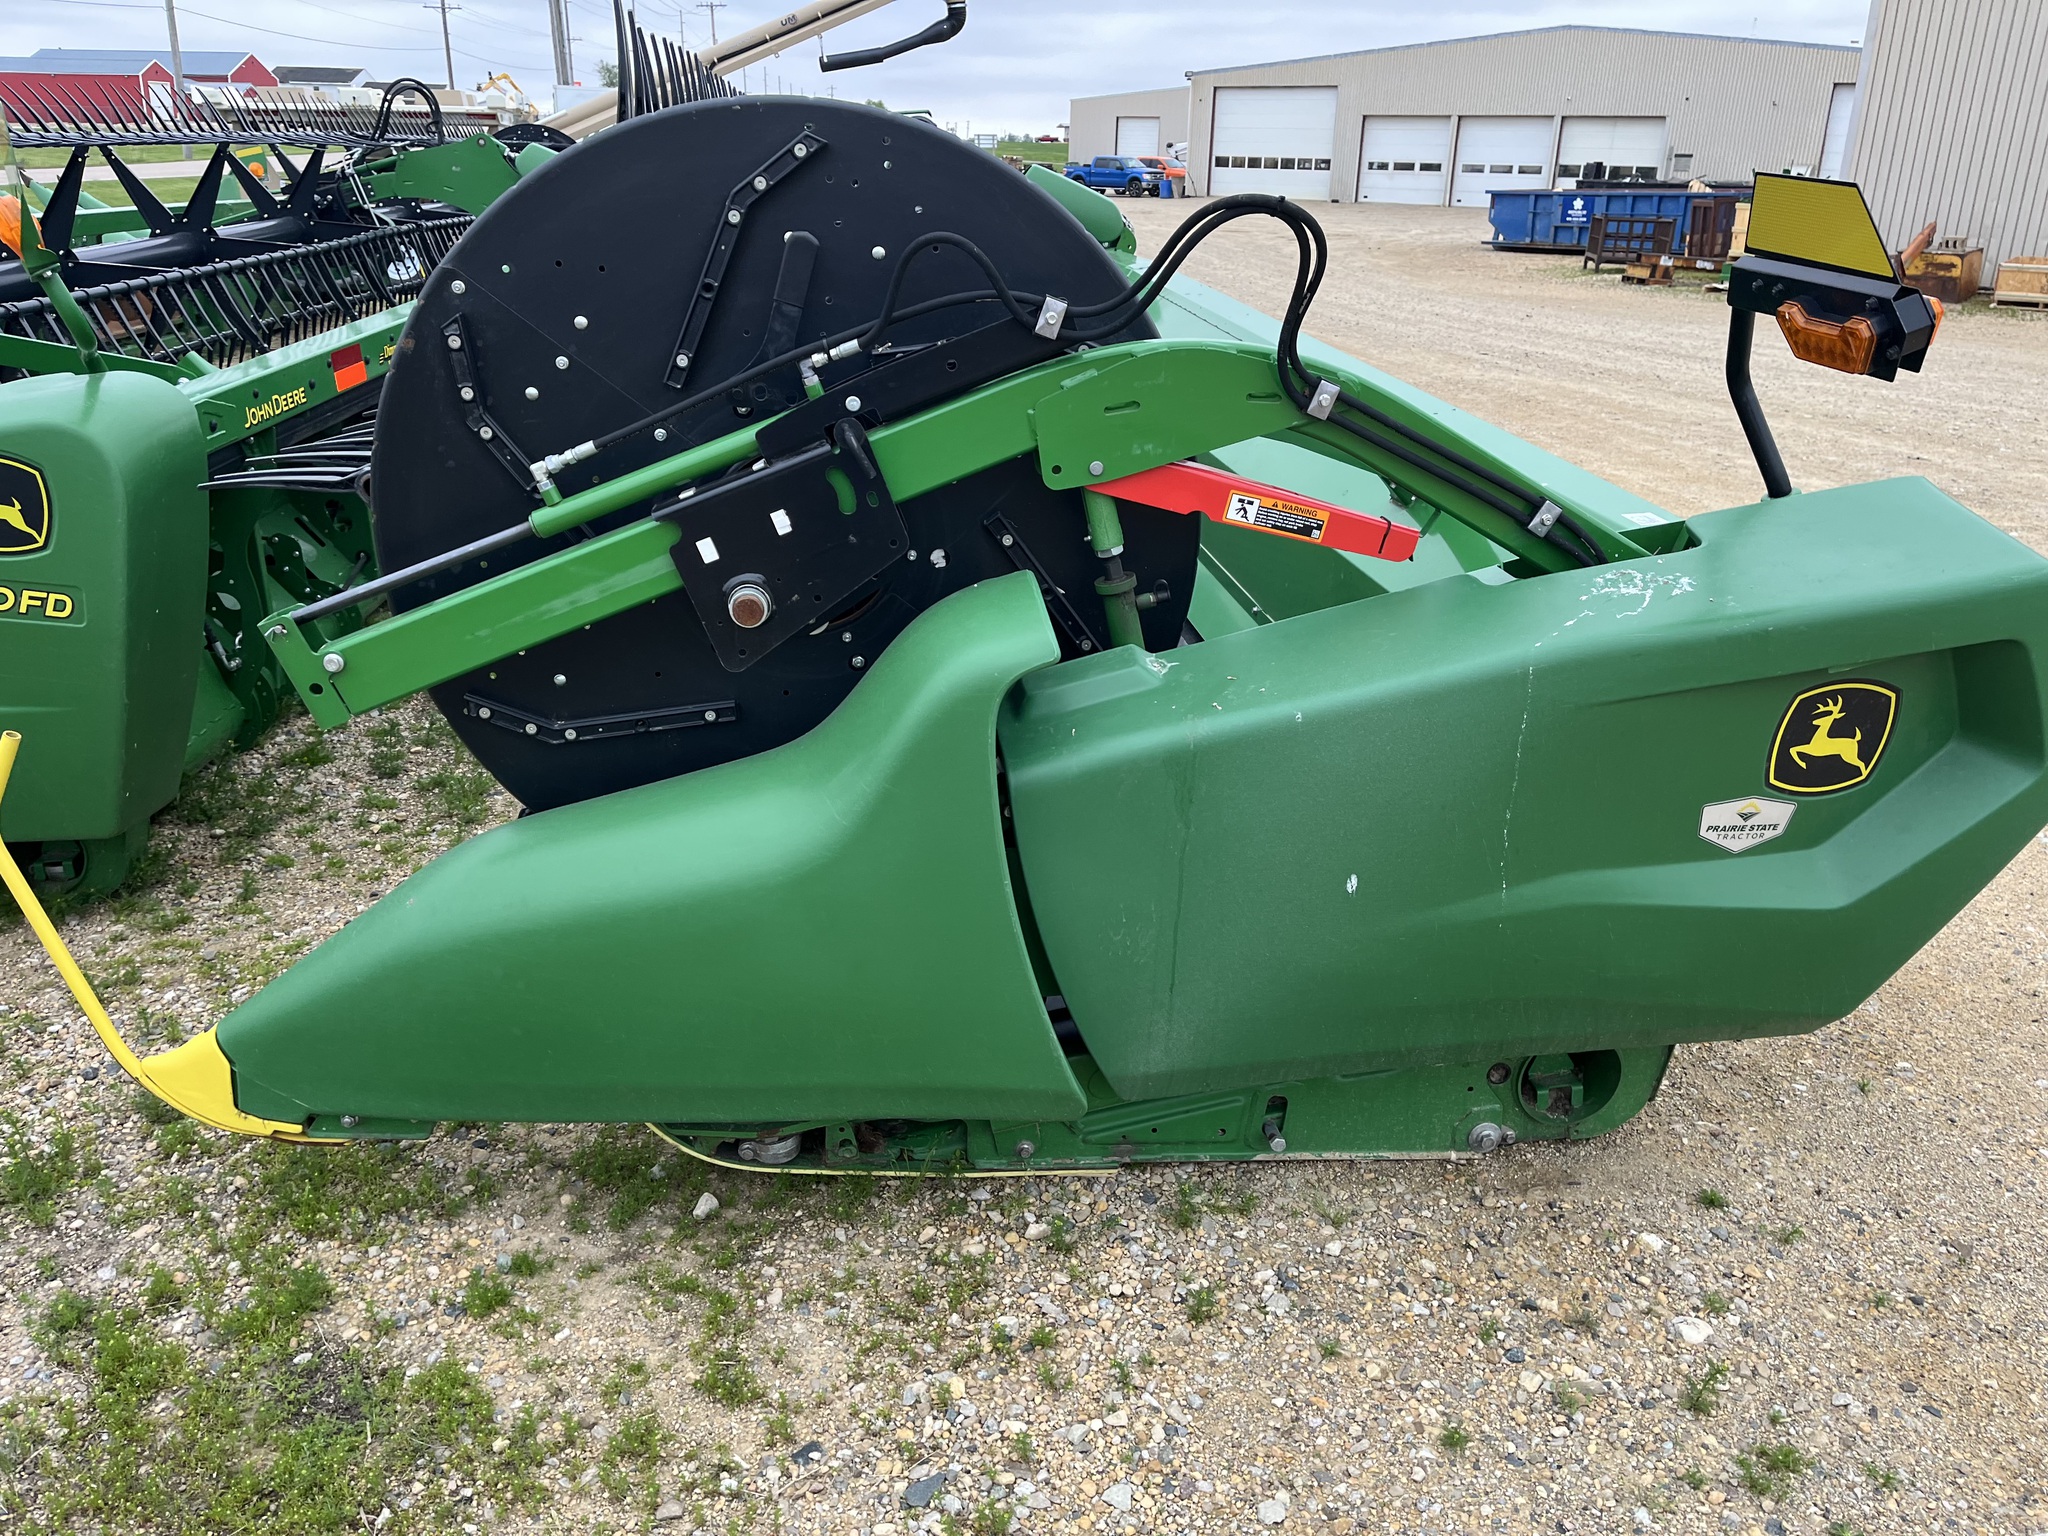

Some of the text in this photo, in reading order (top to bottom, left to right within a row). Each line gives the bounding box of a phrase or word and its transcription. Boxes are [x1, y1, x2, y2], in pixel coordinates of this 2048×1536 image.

[244, 386, 307, 428] JOHN DEERE
[1281, 503, 1318, 518] WARNING
[1705, 823, 1780, 833] PRAIRIE STATE
[1716, 832, 1766, 841] TRACTOR
